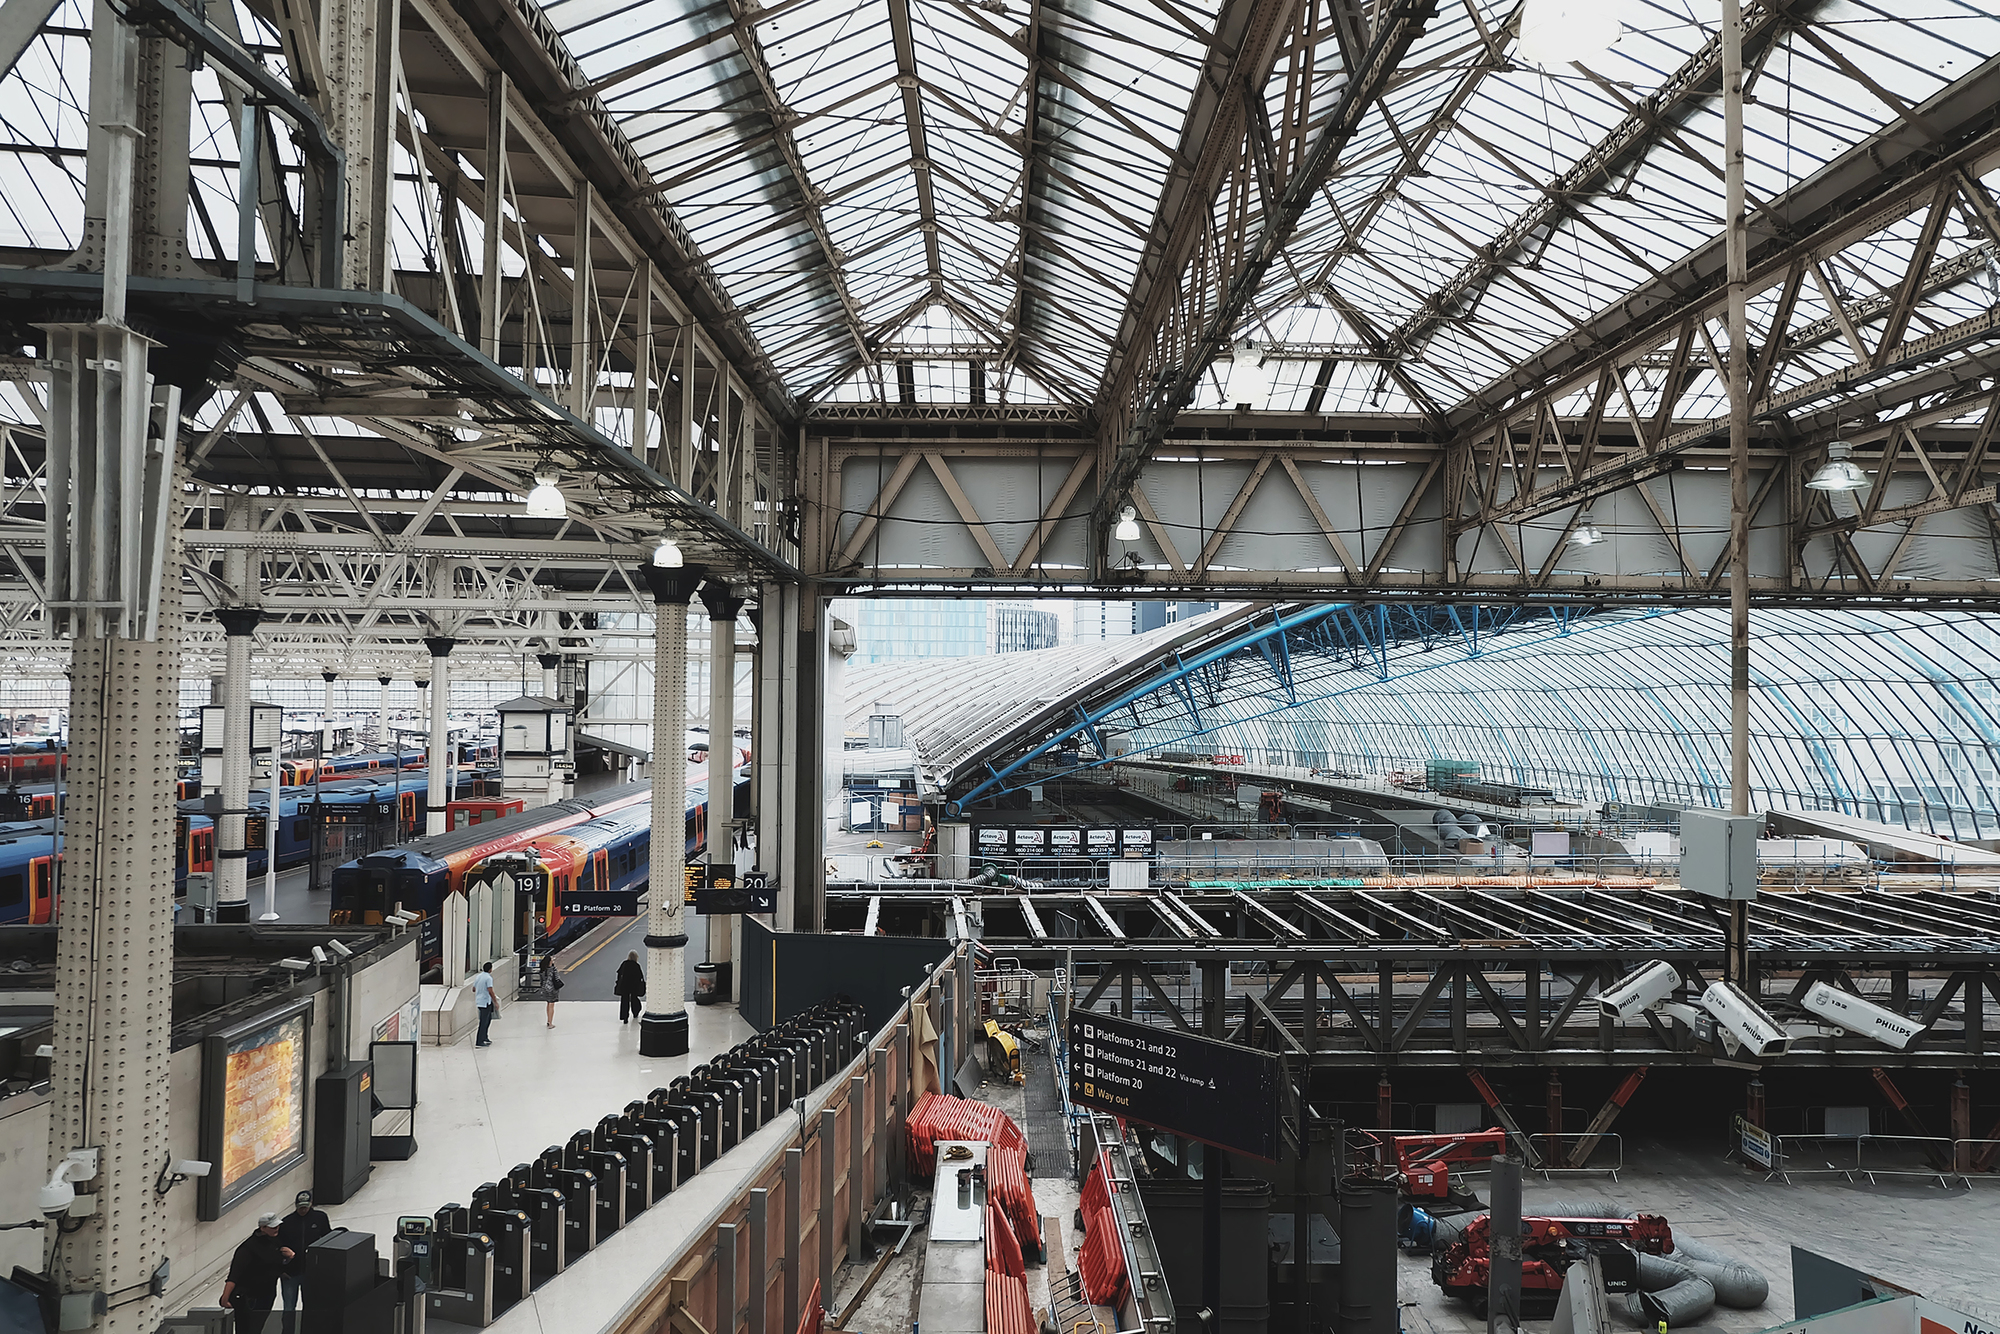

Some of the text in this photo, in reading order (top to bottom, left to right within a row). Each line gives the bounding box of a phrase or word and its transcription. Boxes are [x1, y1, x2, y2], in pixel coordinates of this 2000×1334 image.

[19, 795, 31, 804] 16
[300, 804, 309, 814] 17
[379, 804, 389, 814] 18
[517, 878, 534, 891] 19
[745, 878, 763, 888] 20
[1618, 992, 1640, 1010] PHILIPS
[1741, 1021, 1765, 1045] PHILIPS
[1876, 1018, 1911, 1037] PHILIPS
[1097, 1029, 1177, 1058] Platforms 21 and 22
[1097, 1048, 1205, 1086] Platforms 21 and 22 Via ramp
[1097, 1068, 1143, 1090] Platform 20
[1097, 1087, 1129, 1106] Way out
